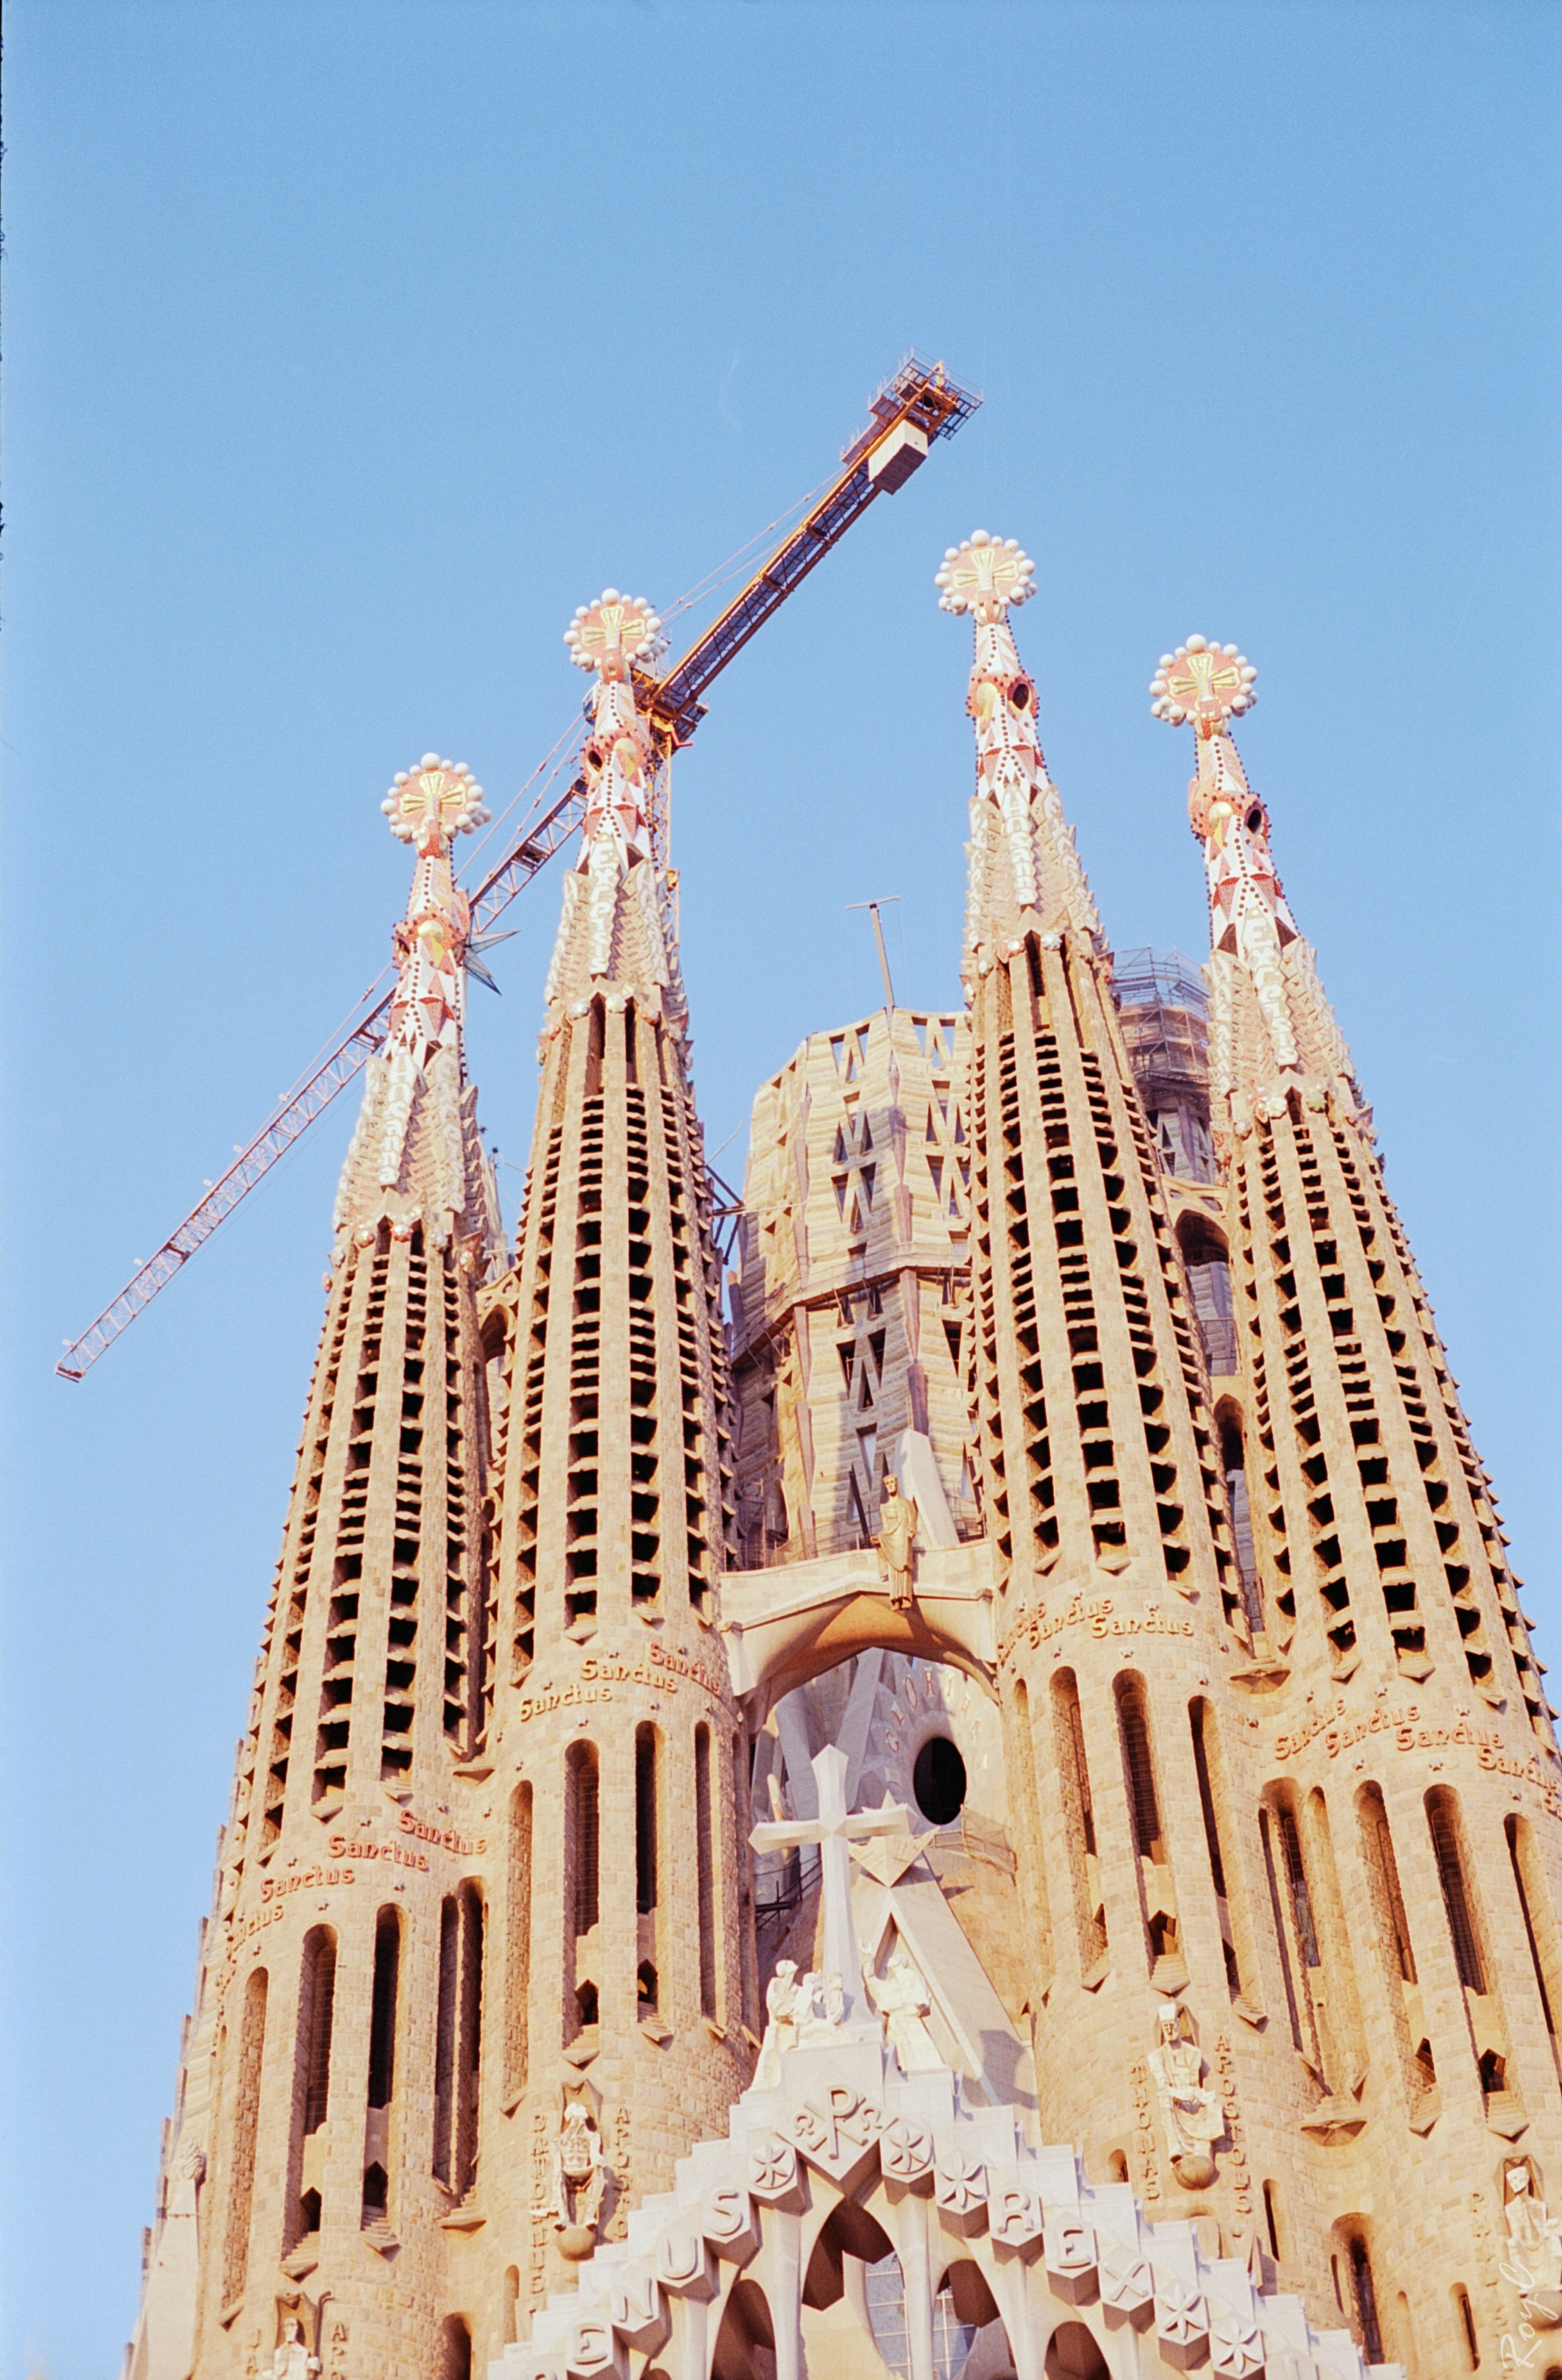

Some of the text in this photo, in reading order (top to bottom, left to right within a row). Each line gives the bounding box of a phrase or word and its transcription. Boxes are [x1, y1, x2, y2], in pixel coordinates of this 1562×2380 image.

[1028, 1597, 1113, 1650] Sanctus
[1091, 1611, 1194, 1639] Sanctus
[581, 1657, 678, 1694] Sanctus
[649, 1641, 722, 1696] Sanctus
[519, 1683, 612, 1722] Sanctus
[1274, 1699, 1346, 1759] Sanctus
[1325, 1706, 1421, 1759] Sanctus
[1396, 1722, 1504, 1752] Sanctus
[328, 1834, 428, 1872] Sanctus
[399, 1809, 487, 1855] Sanctus
[261, 1864, 356, 1904] Sanctus
[997, 2186, 1149, 2301] REX
